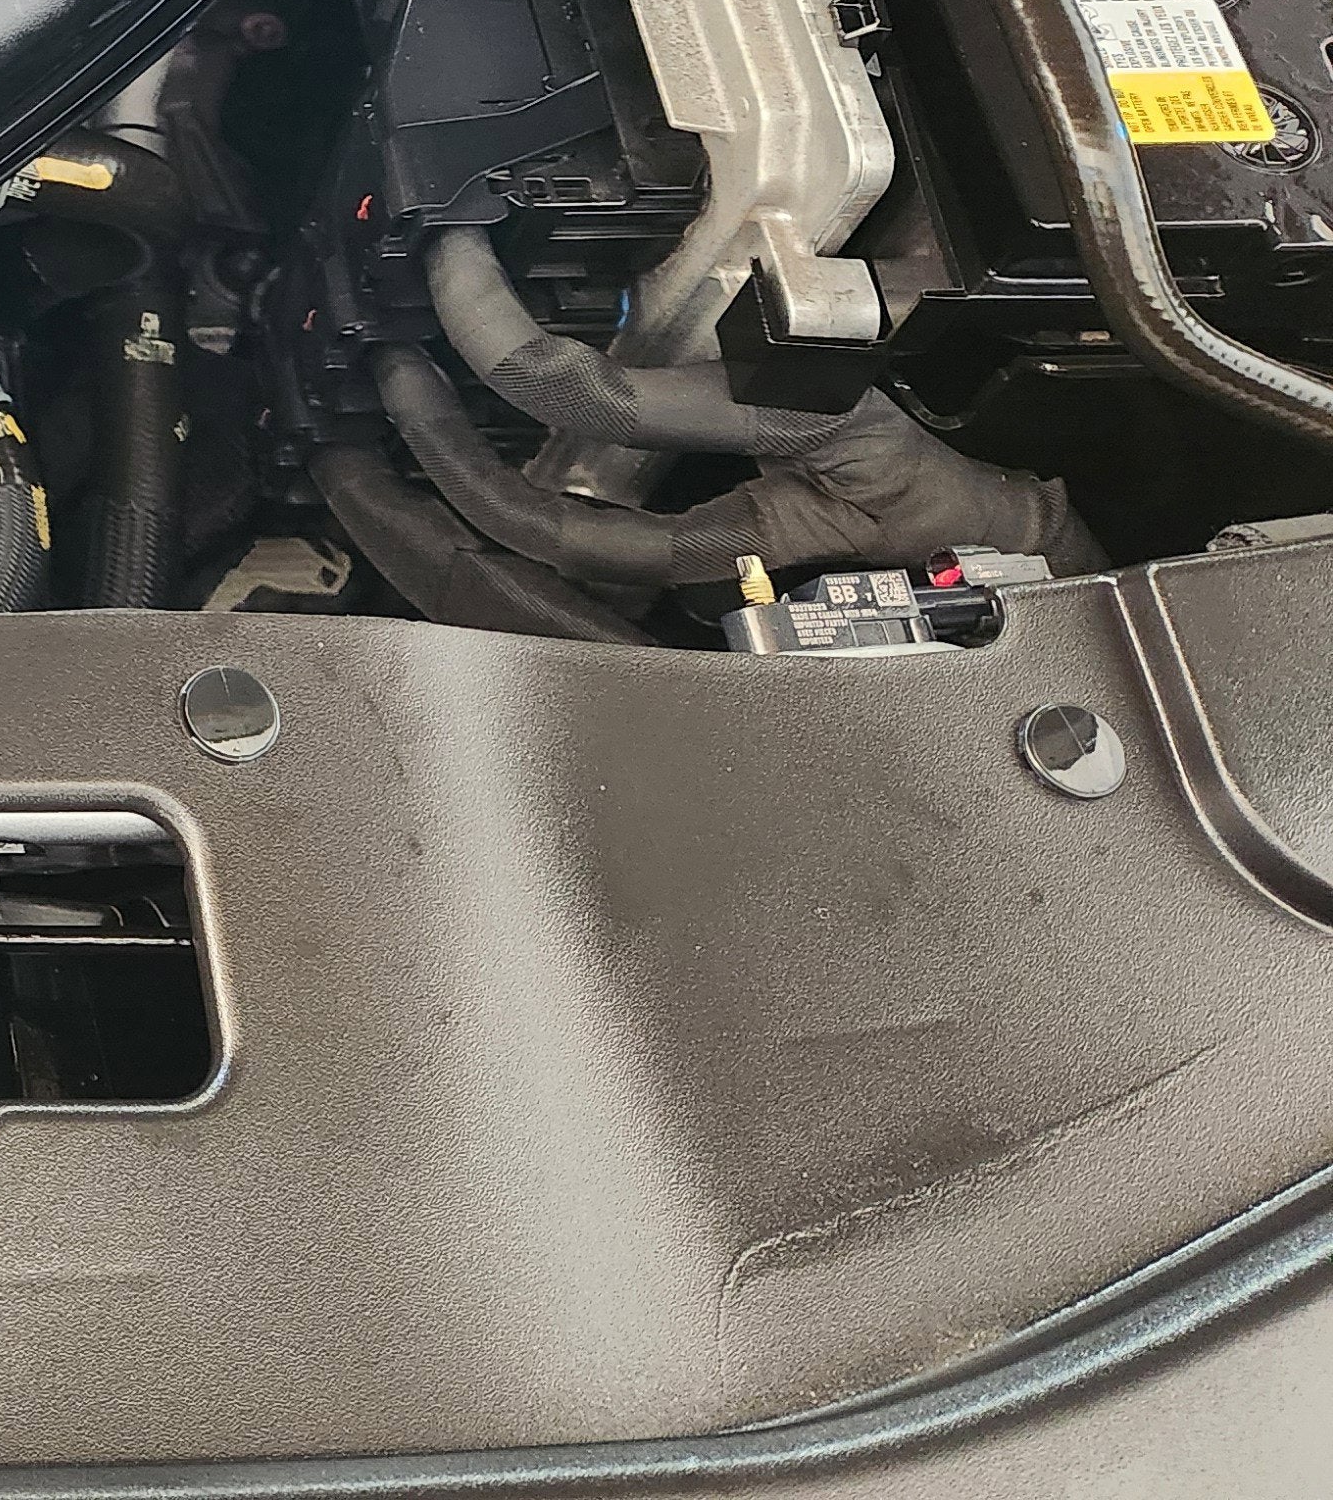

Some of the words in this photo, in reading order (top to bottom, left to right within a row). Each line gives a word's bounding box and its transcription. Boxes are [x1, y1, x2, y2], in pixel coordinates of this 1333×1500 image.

[1150, 6, 1169, 21] YEUX
[1125, 20, 1142, 37] CAUSE
[1144, 29, 1157, 37] OR
[1159, 24, 1174, 34] LES
[1171, 16, 1194, 44] EXPLOSIFS
[1187, 19, 1207, 42] BLESSER
[1134, 39, 1147, 50] CAN
[1147, 39, 1172, 67] BLINDNESS
[1111, 54, 1129, 68] EYES
[1119, 41, 1142, 68] EXPLOSIVE
[1139, 51, 1157, 68] GASES
[1190, 58, 1205, 67] LES
[1201, 77, 1225, 110] COUVERCLES
[1128, 93, 1147, 117] BATTERY
[827, 585, 858, 604] BB
